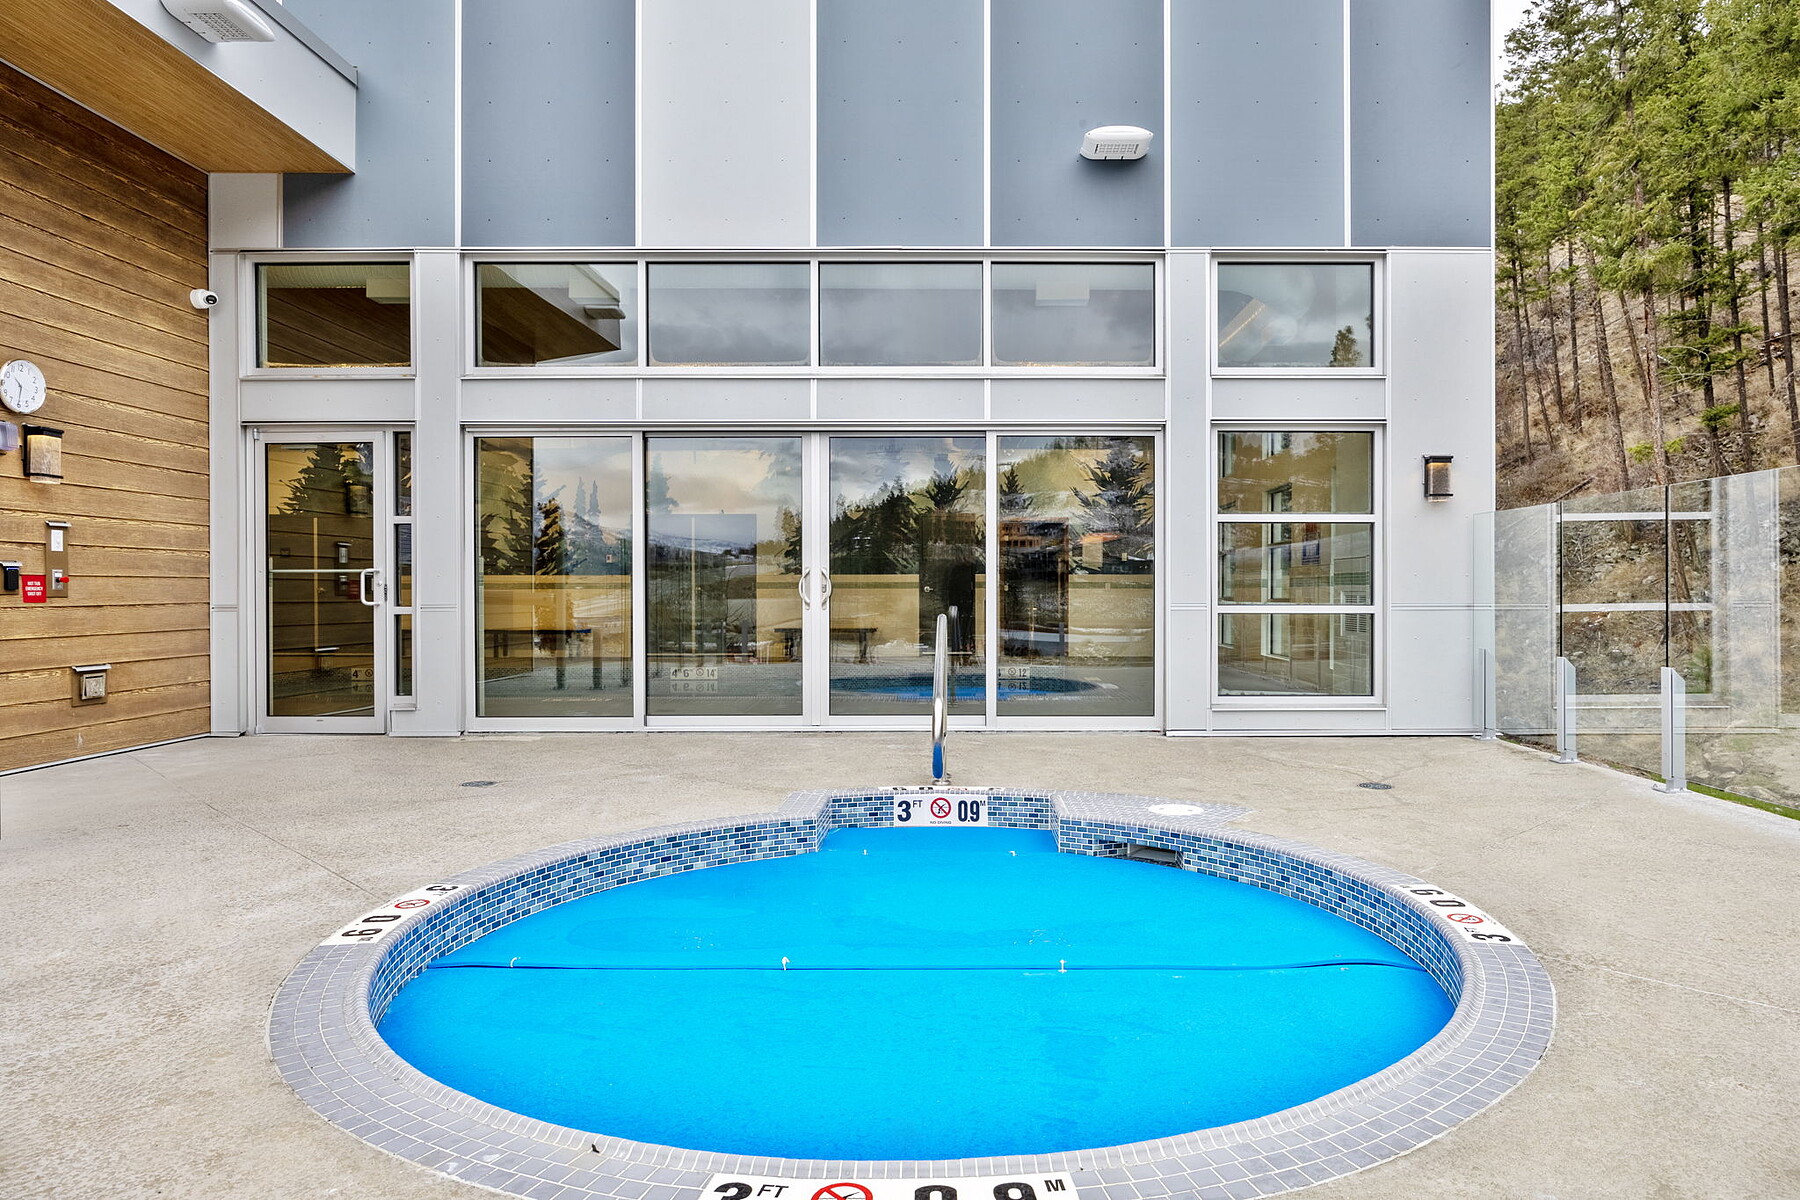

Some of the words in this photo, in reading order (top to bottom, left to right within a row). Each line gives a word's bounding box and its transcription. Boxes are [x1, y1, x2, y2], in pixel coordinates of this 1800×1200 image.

[17, 363, 24, 372] 12
[34, 386, 38, 394] 3
[352, 670, 359, 678] 4
[672, 669, 678, 678] 4
[897, 800, 912, 822] 3
[912, 800, 923, 808] FT
[957, 800, 980, 822] 0.9
[1471, 933, 1511, 942] 3
[757, 1184, 789, 1198] FT
[1044, 1179, 1066, 1192] M
